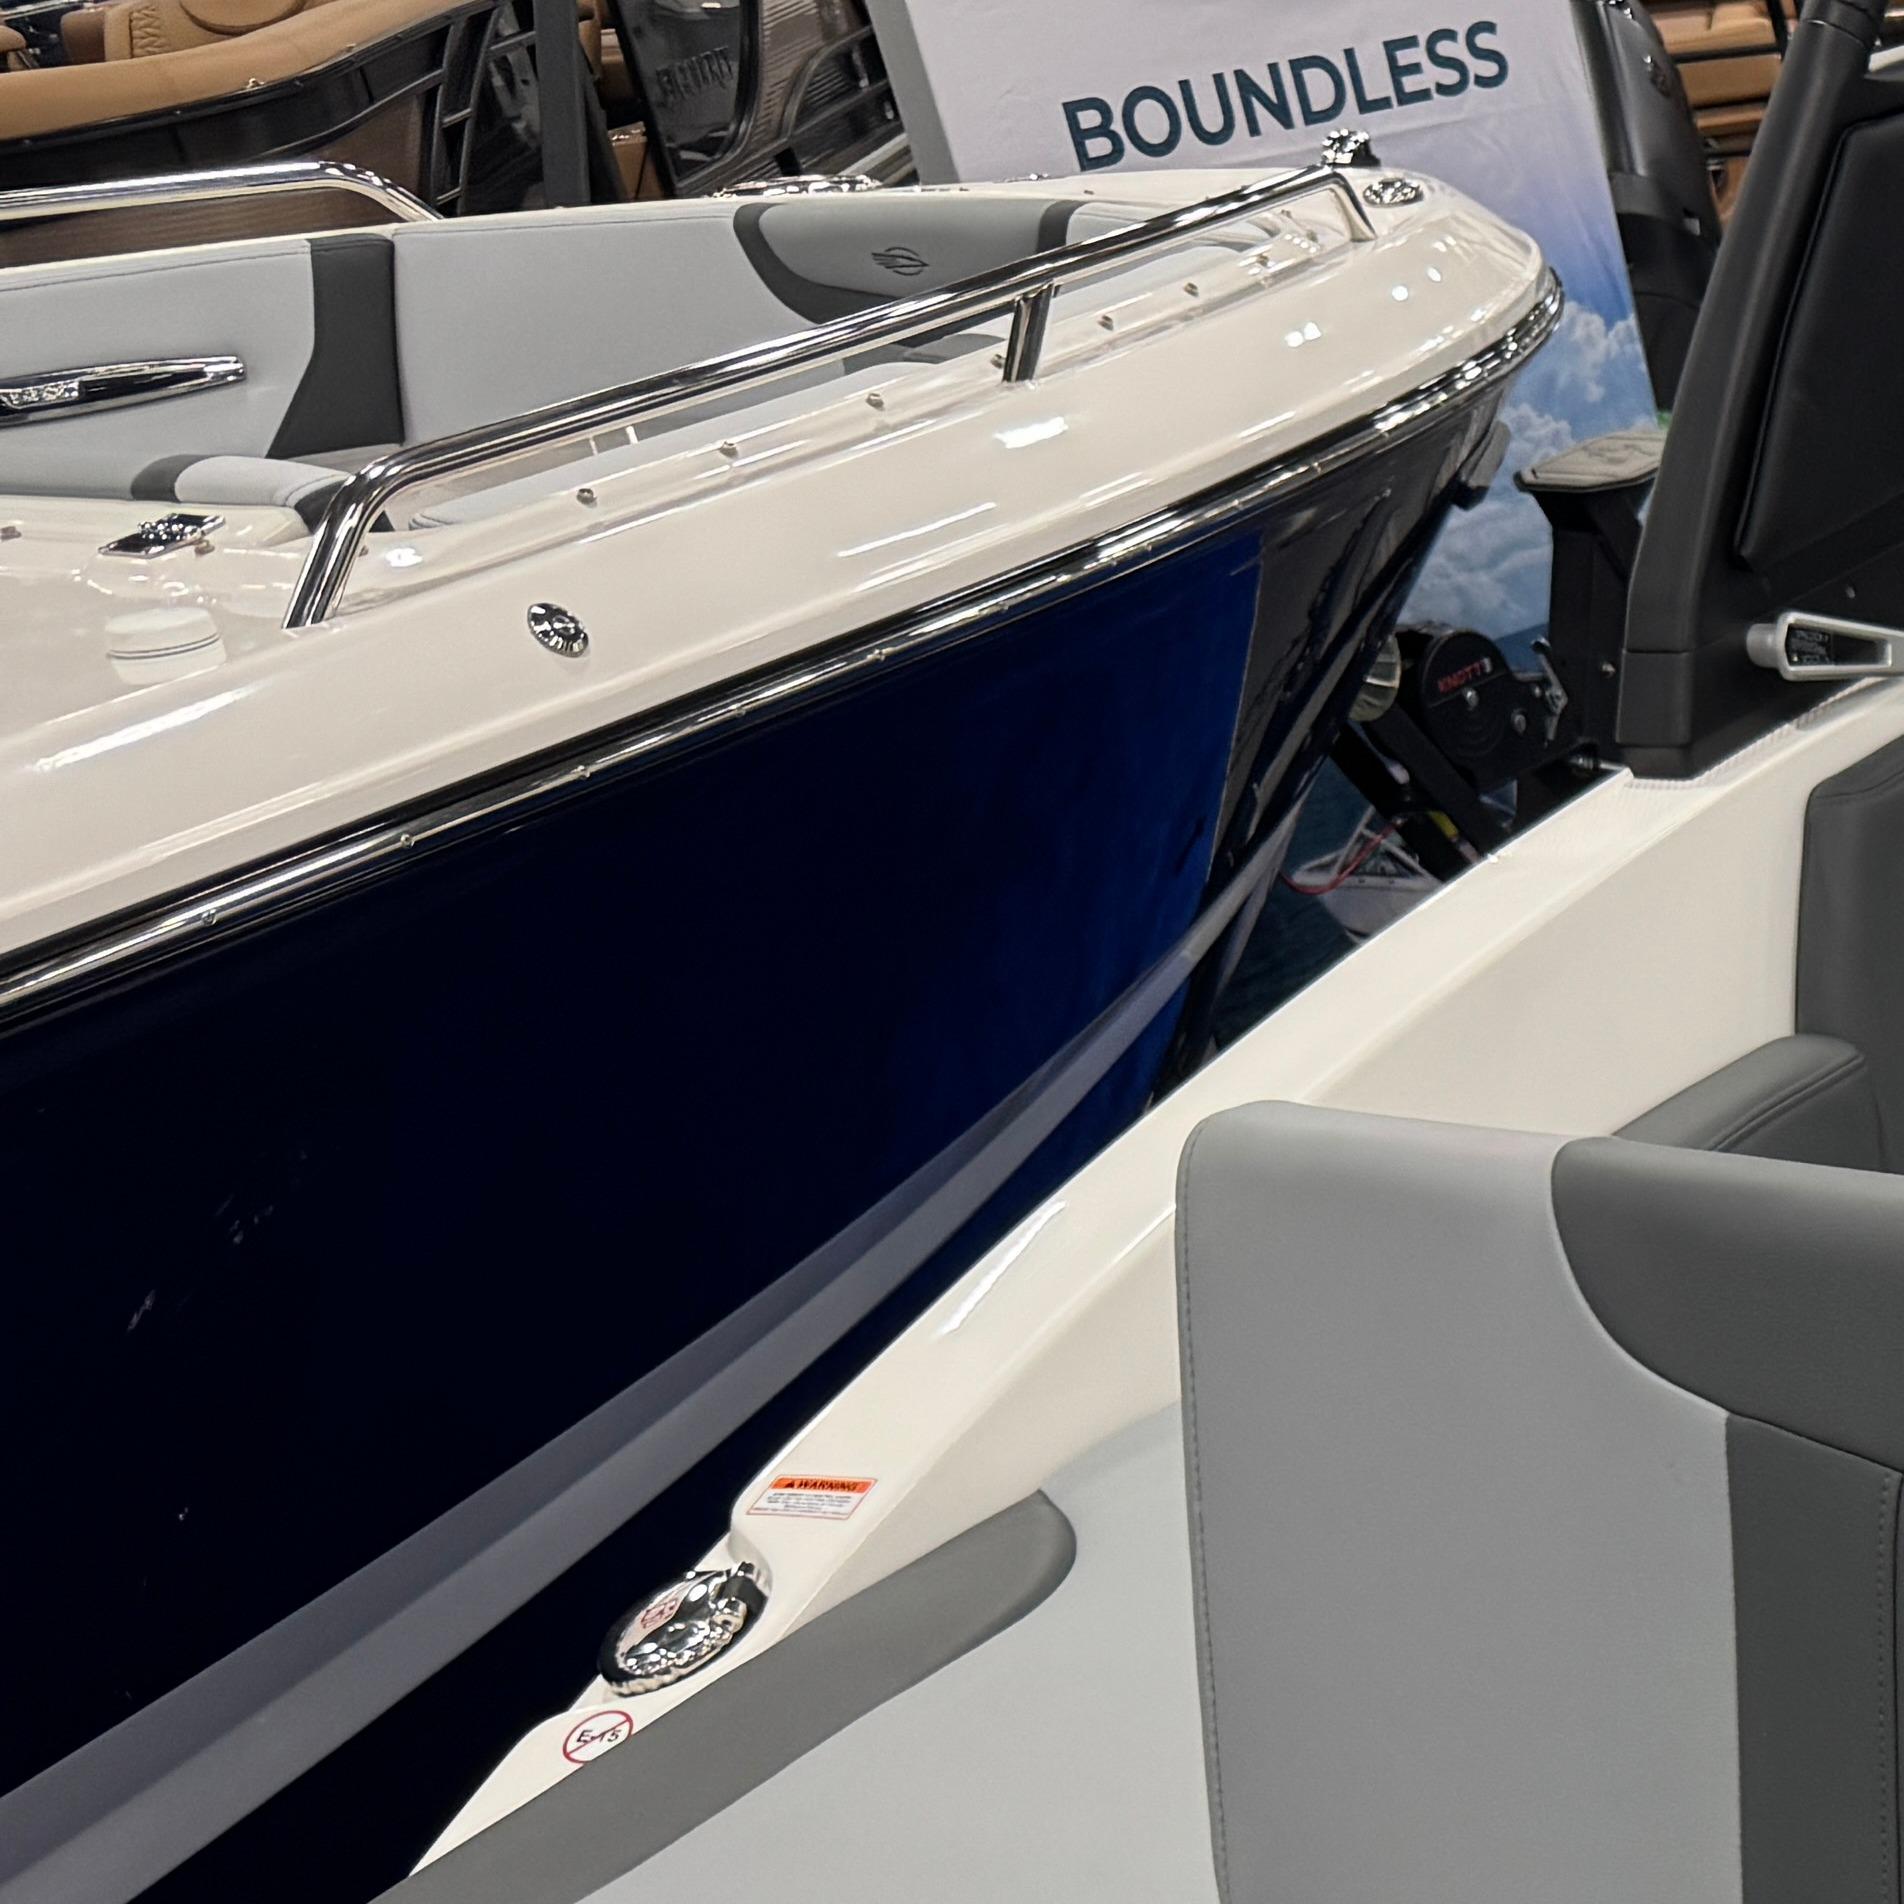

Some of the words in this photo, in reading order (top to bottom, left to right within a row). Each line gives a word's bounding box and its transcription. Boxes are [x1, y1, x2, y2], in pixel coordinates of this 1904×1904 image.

[1061, 20, 1509, 172] BOUNDLESS
[800, 1479, 858, 1493] WARNING
[577, 1729, 621, 1743] E-15
